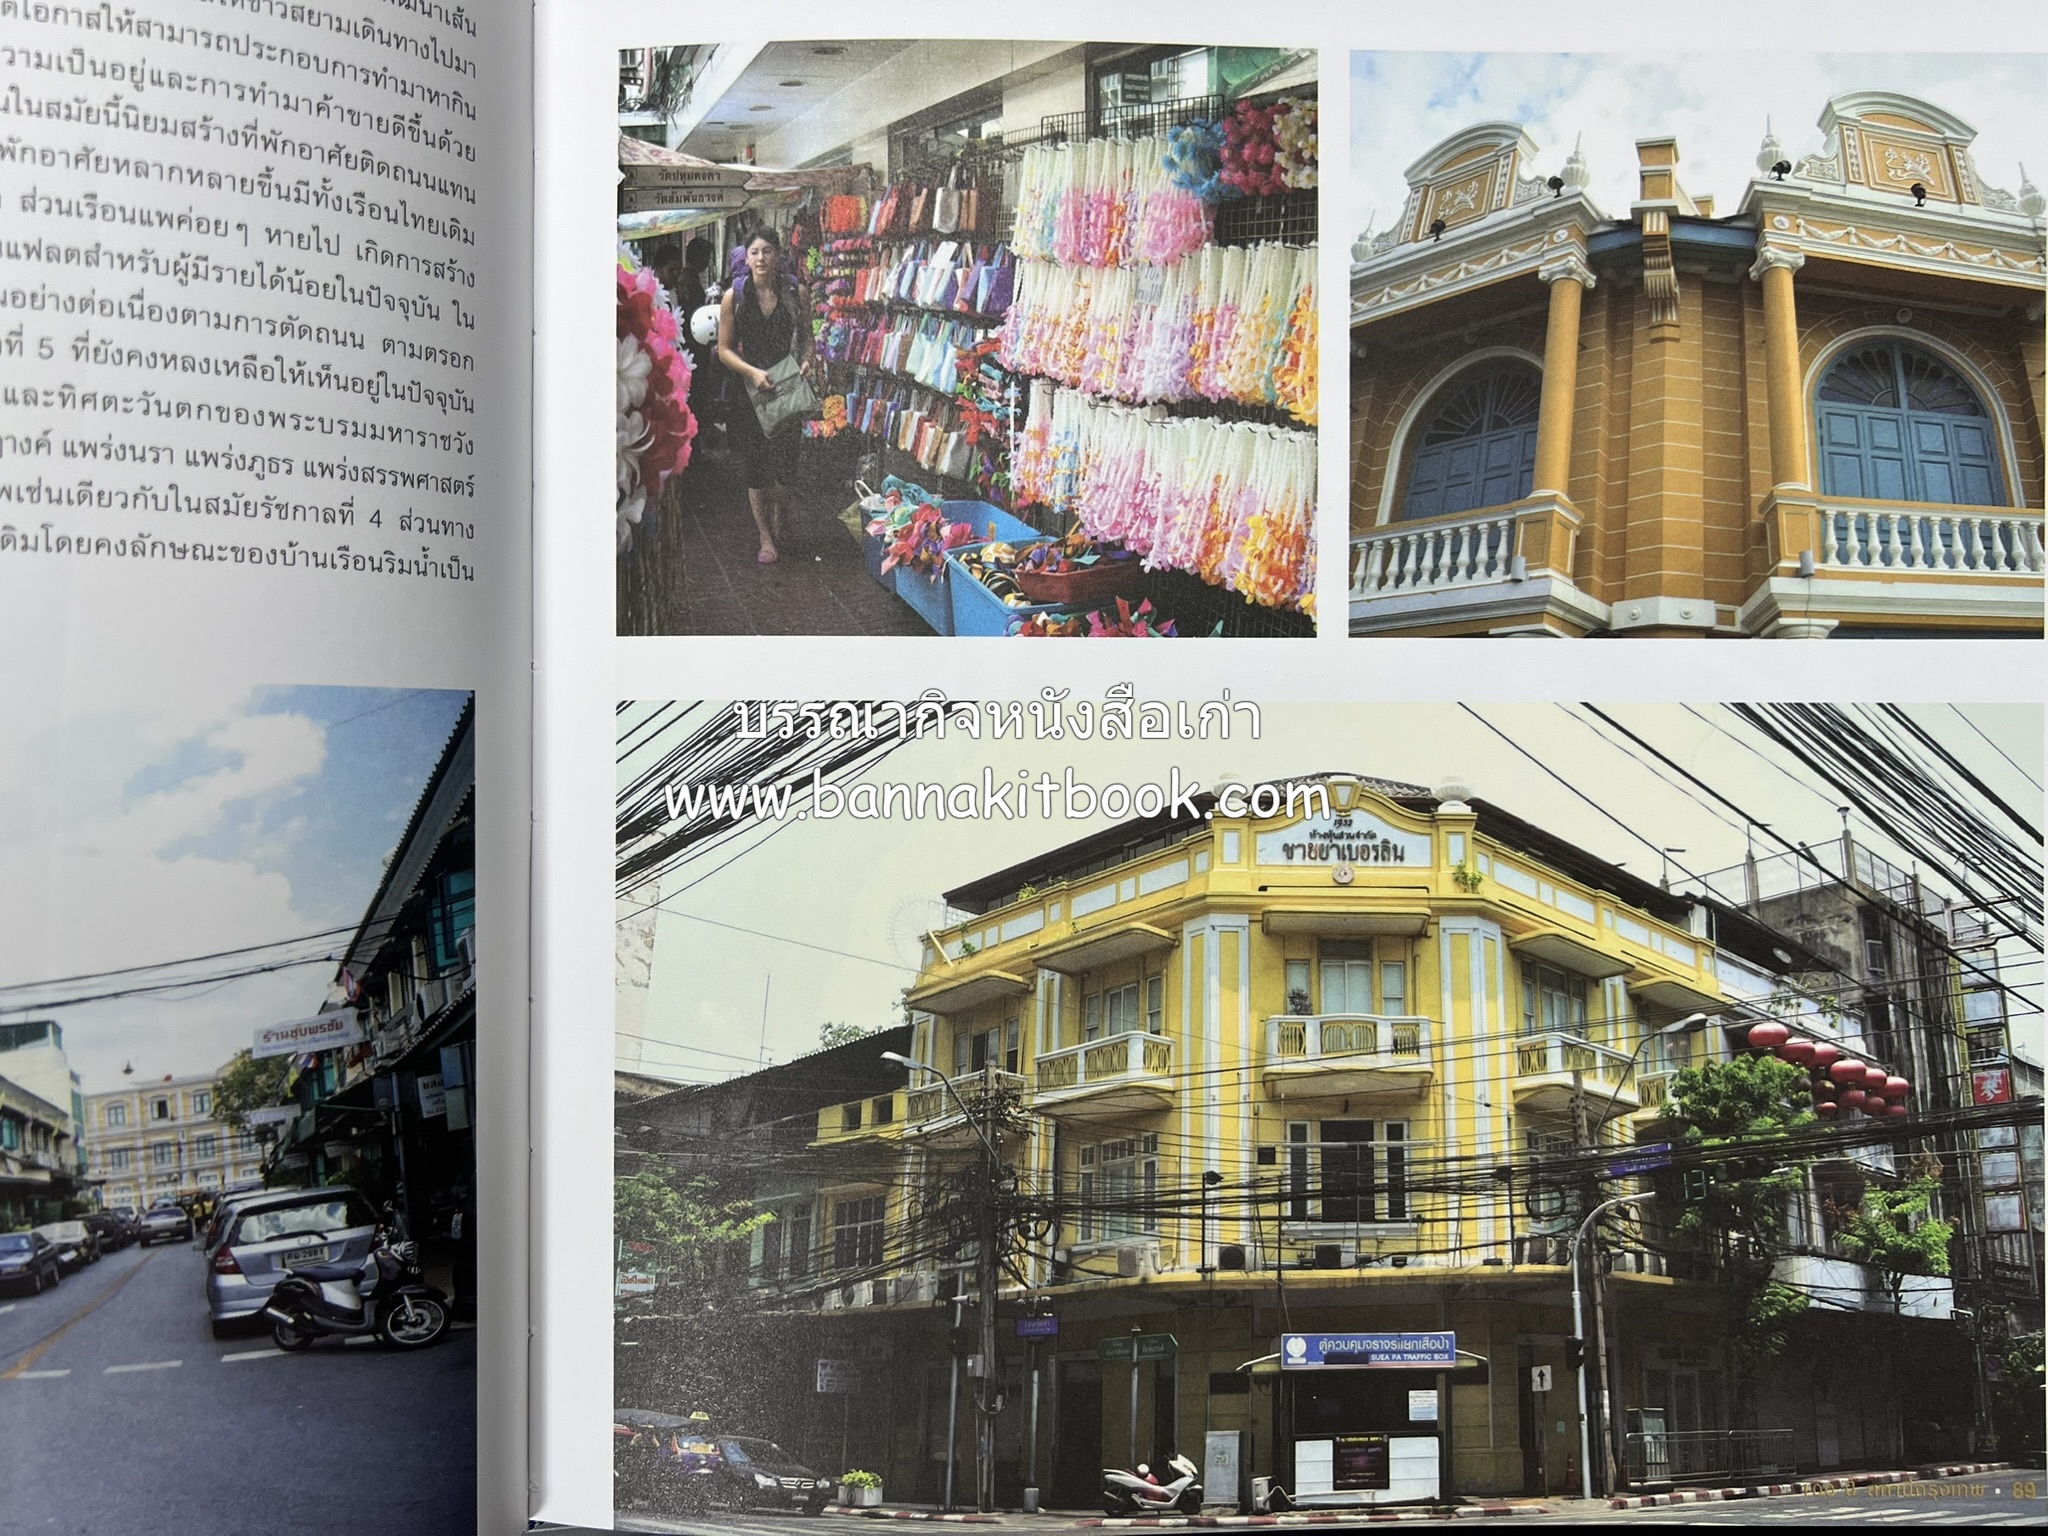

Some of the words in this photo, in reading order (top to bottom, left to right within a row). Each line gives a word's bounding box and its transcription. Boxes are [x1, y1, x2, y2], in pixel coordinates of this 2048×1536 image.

[264, 225, 340, 256] หายไป
[356, 239, 475, 288] เกิดการสร้าง
[0, 238, 440, 322] แฟลตสำหรับผู้มีรายได้น้อยในปัจจุบัน
[452, 299, 475, 330] ใน
[0, 323, 24, 358] ที่
[38, 336, 54, 360] 5
[382, 336, 474, 372] ตามตรอก
[0, 429, 52, 460] างค์
[63, 433, 174, 465] แพร่งนรา
[185, 443, 294, 481] แพร่งภูธร
[304, 456, 475, 498] แพร่งสรรพศาสตร์
[369, 508, 382, 528] 4
[400, 507, 474, 540] ส่วนทาง
[1319, 1336, 1449, 1355] ตู้ควบคุมจราจรแยกเสือป่า
[1403, 1353, 1432, 1361] TRAFFIC
[2012, 1481, 2036, 1499] 89
